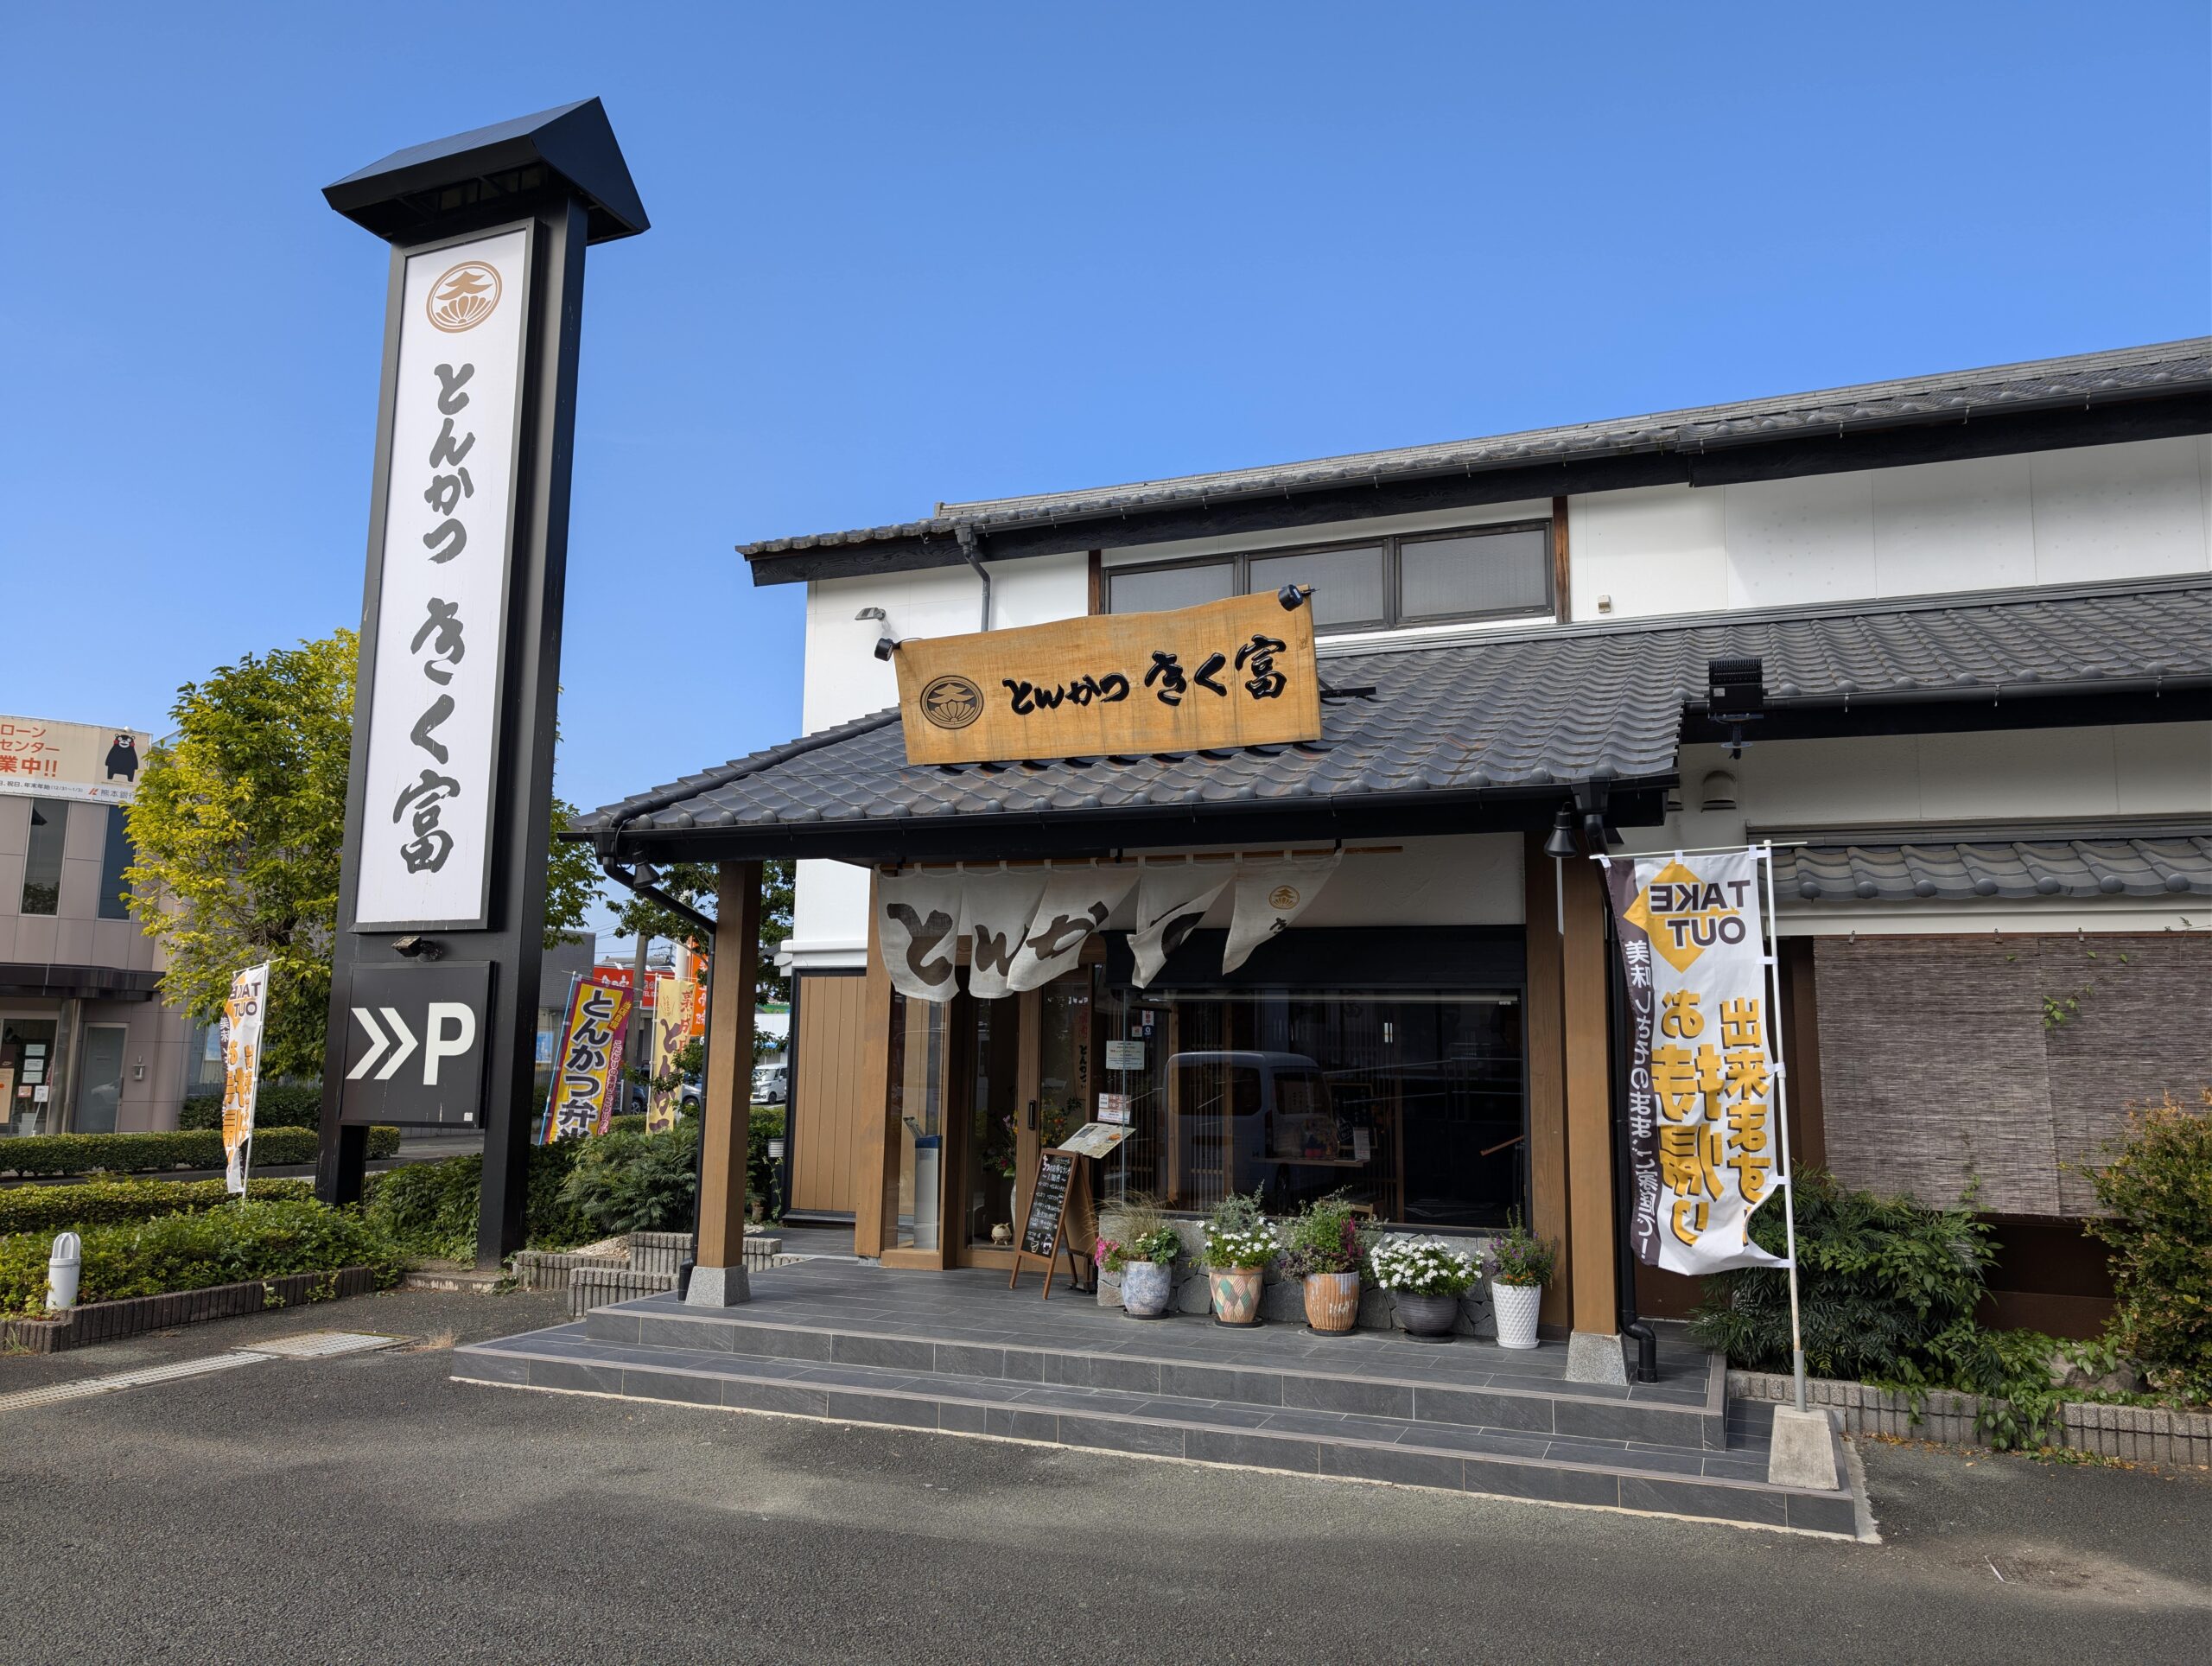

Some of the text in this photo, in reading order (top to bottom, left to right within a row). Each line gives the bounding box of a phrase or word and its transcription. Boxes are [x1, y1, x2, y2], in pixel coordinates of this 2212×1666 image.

[423, 362, 476, 564] とんかつ
[1001, 672, 1130, 715] とんかつ
[1144, 633, 1287, 706] きく富
[0, 739, 60, 753] センター
[391, 597, 466, 875] きく富
[423, 1002, 476, 1086] P
